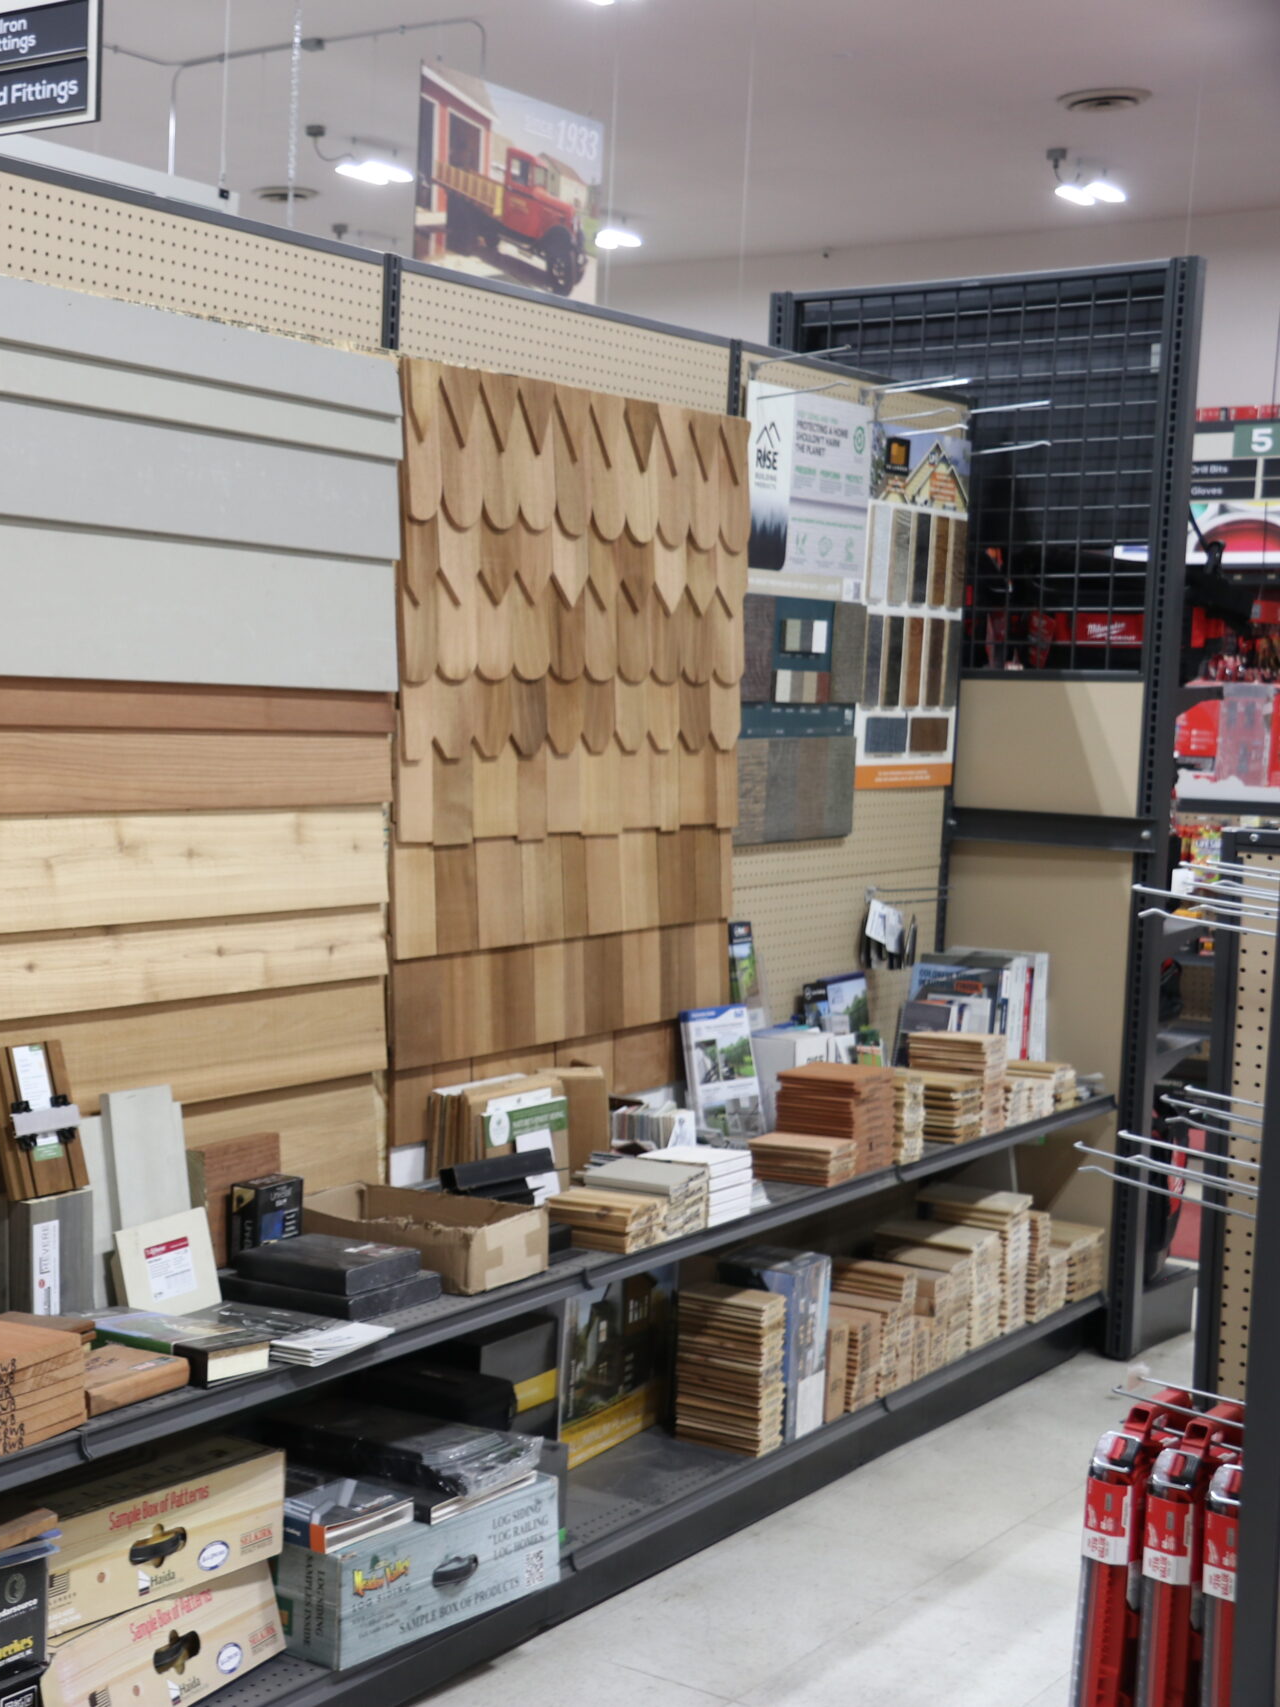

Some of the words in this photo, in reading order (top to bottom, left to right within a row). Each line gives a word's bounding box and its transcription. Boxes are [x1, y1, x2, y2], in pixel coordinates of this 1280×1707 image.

[0, 18, 27, 35] Iron
[11, 77, 78, 105] Fittings
[557, 120, 599, 160] 1933
[1251, 427, 1274, 453] 5
[756, 448, 778, 470] RISE
[1209, 465, 1228, 474] Bits
[1191, 486, 1223, 496] Gloves
[109, 1503, 141, 1530] Sample
[142, 1500, 159, 1518] Box
[160, 1494, 170, 1513] of
[170, 1485, 210, 1509] Patterns
[492, 1514, 511, 1529] LOG
[151, 1570, 176, 1586] Haida
[129, 1615, 156, 1641] Sample
[156, 1608, 171, 1625] Box
[171, 1599, 180, 1619] of
[180, 1588, 213, 1614] Patterns
[399, 1611, 437, 1634] SAMPLE
[438, 1601, 459, 1618] BOX
[460, 1597, 471, 1610] OF
[474, 1577, 519, 1604] PRODUCTS
[179, 1676, 200, 1695] Haida
